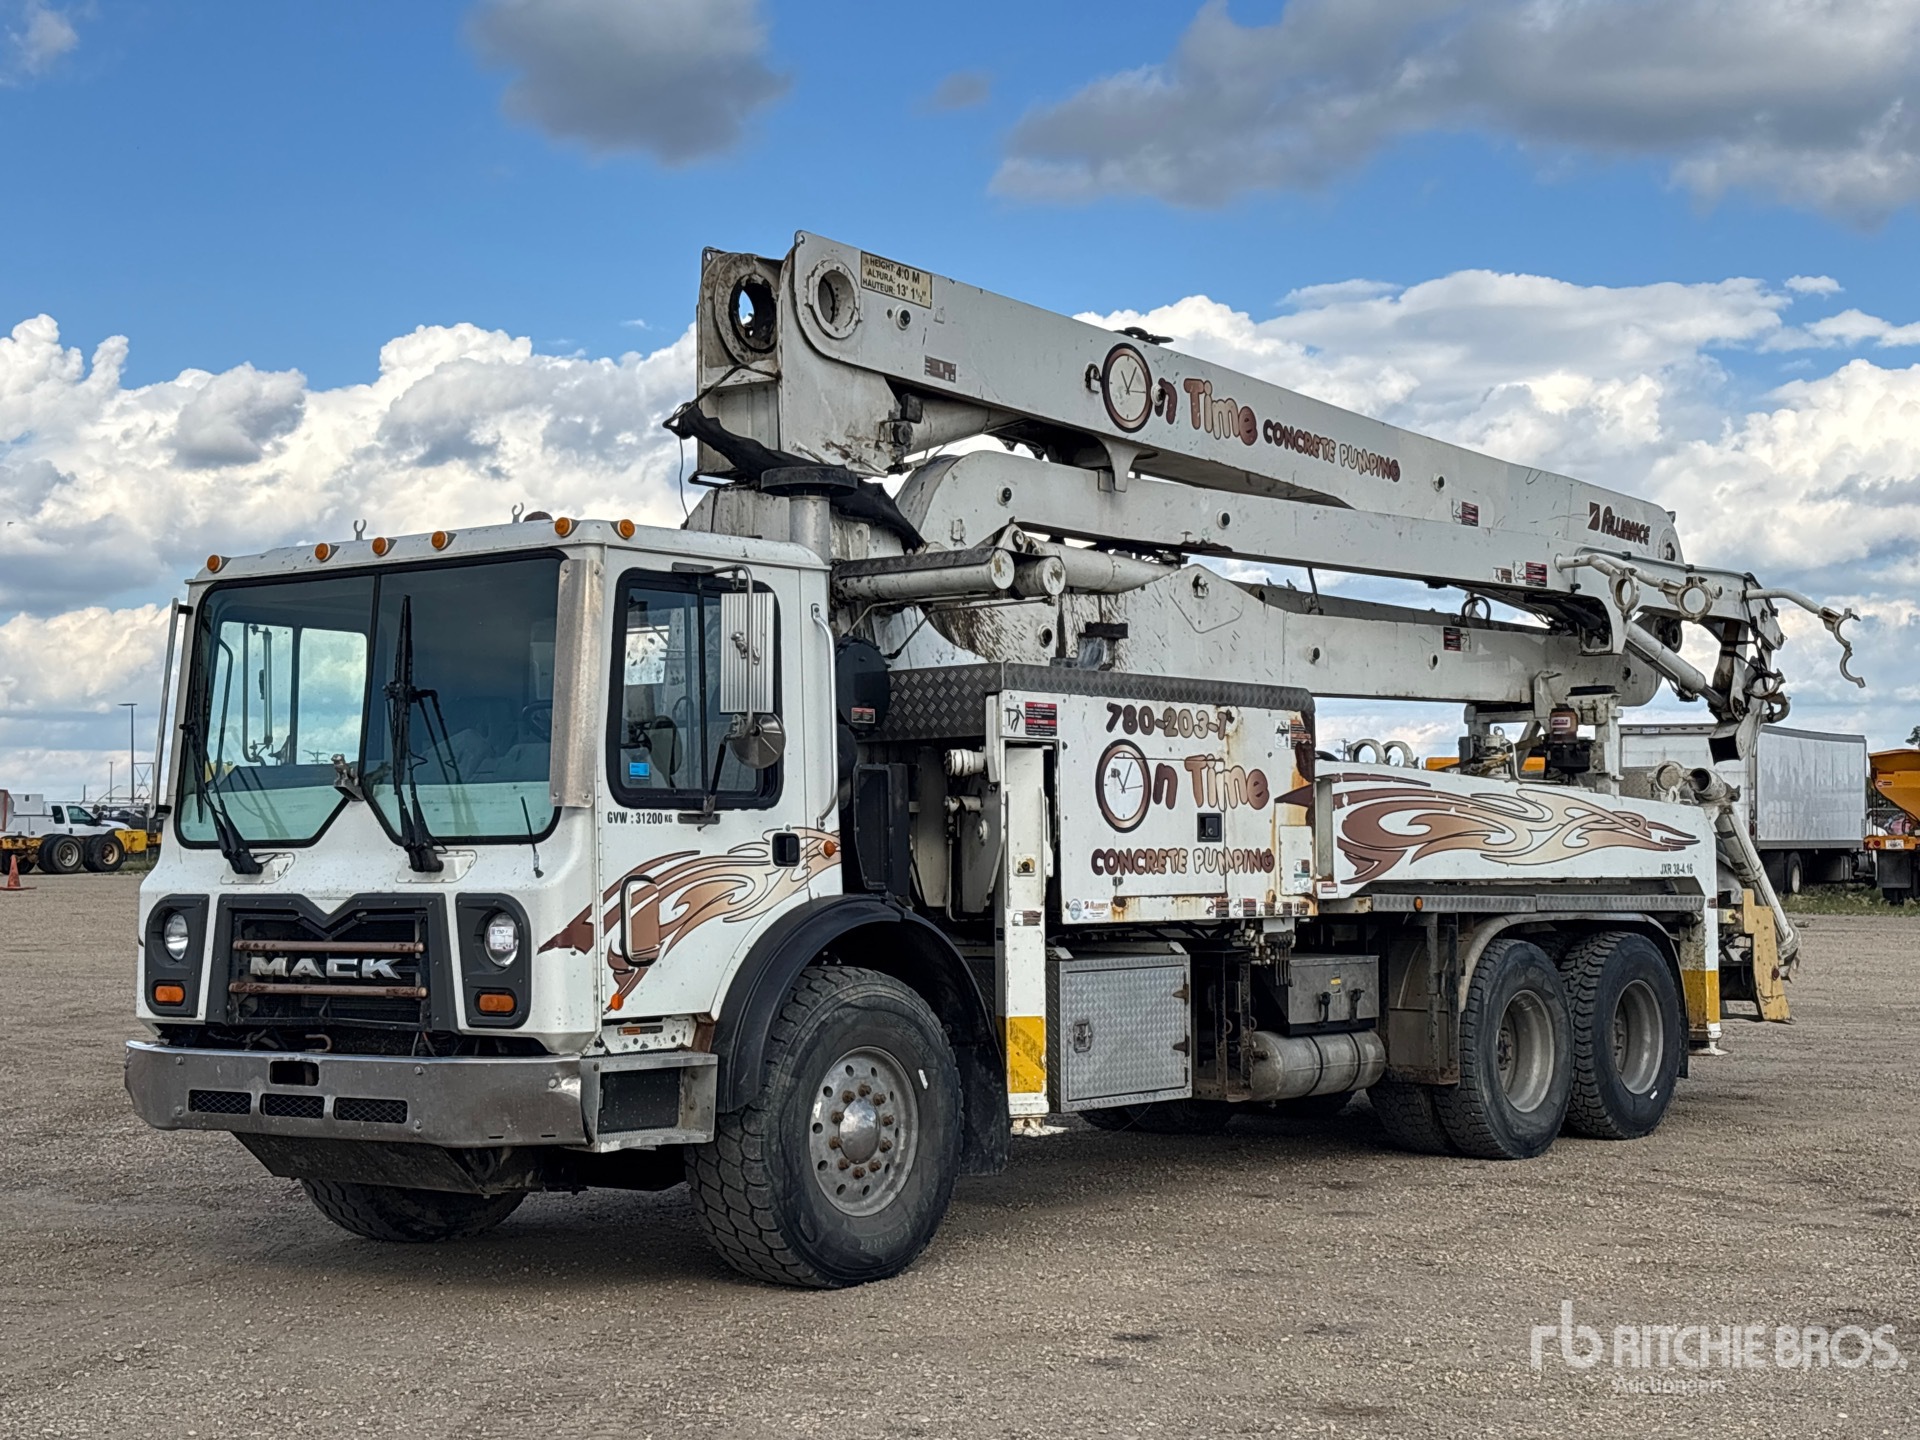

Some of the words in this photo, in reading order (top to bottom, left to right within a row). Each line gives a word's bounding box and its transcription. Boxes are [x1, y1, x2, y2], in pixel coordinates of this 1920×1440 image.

[912, 271, 920, 285] M
[1184, 378, 1258, 446] Time
[1263, 419, 1336, 464] CONCRETE
[1339, 443, 1400, 482] PUMPING
[1184, 753, 1270, 812] Time
[607, 811, 628, 824] GVW
[635, 812, 663, 825] 31200
[664, 813, 673, 823] KG
[1091, 848, 1189, 876] CONCRETE
[1193, 847, 1275, 876] PUMPING
[1660, 863, 1672, 875] JXR
[250, 956, 402, 980] MACK
